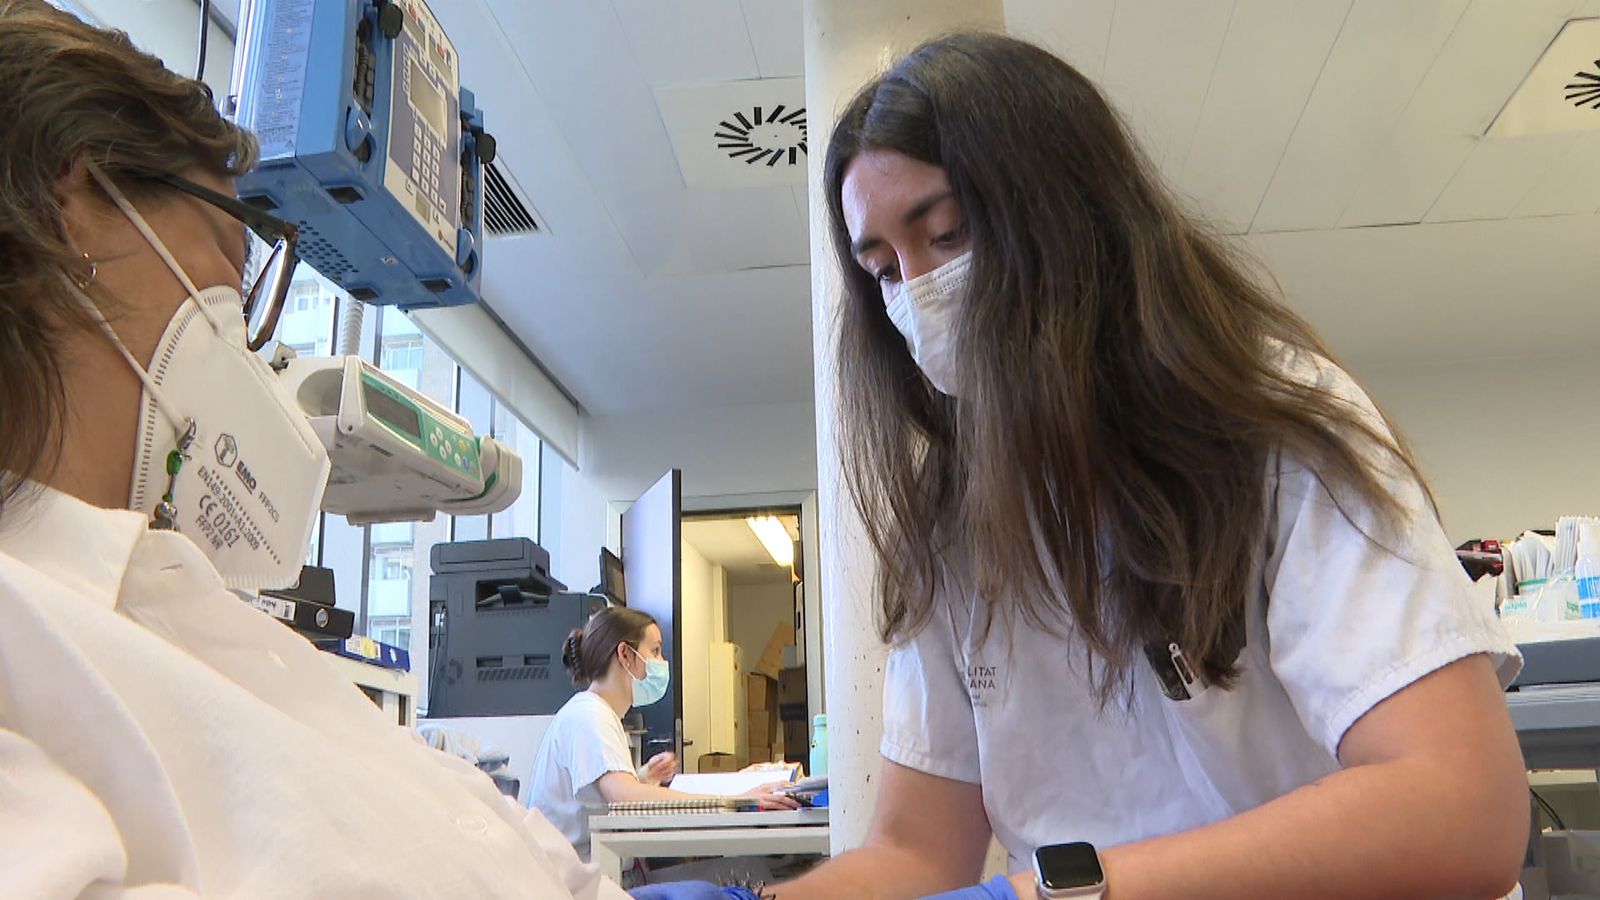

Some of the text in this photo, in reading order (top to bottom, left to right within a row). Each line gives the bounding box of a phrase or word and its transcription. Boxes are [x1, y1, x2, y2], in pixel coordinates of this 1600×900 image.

[237, 460, 257, 490] EMO
[195, 515, 214, 540] FFP2
[213, 512, 240, 548] 0161
